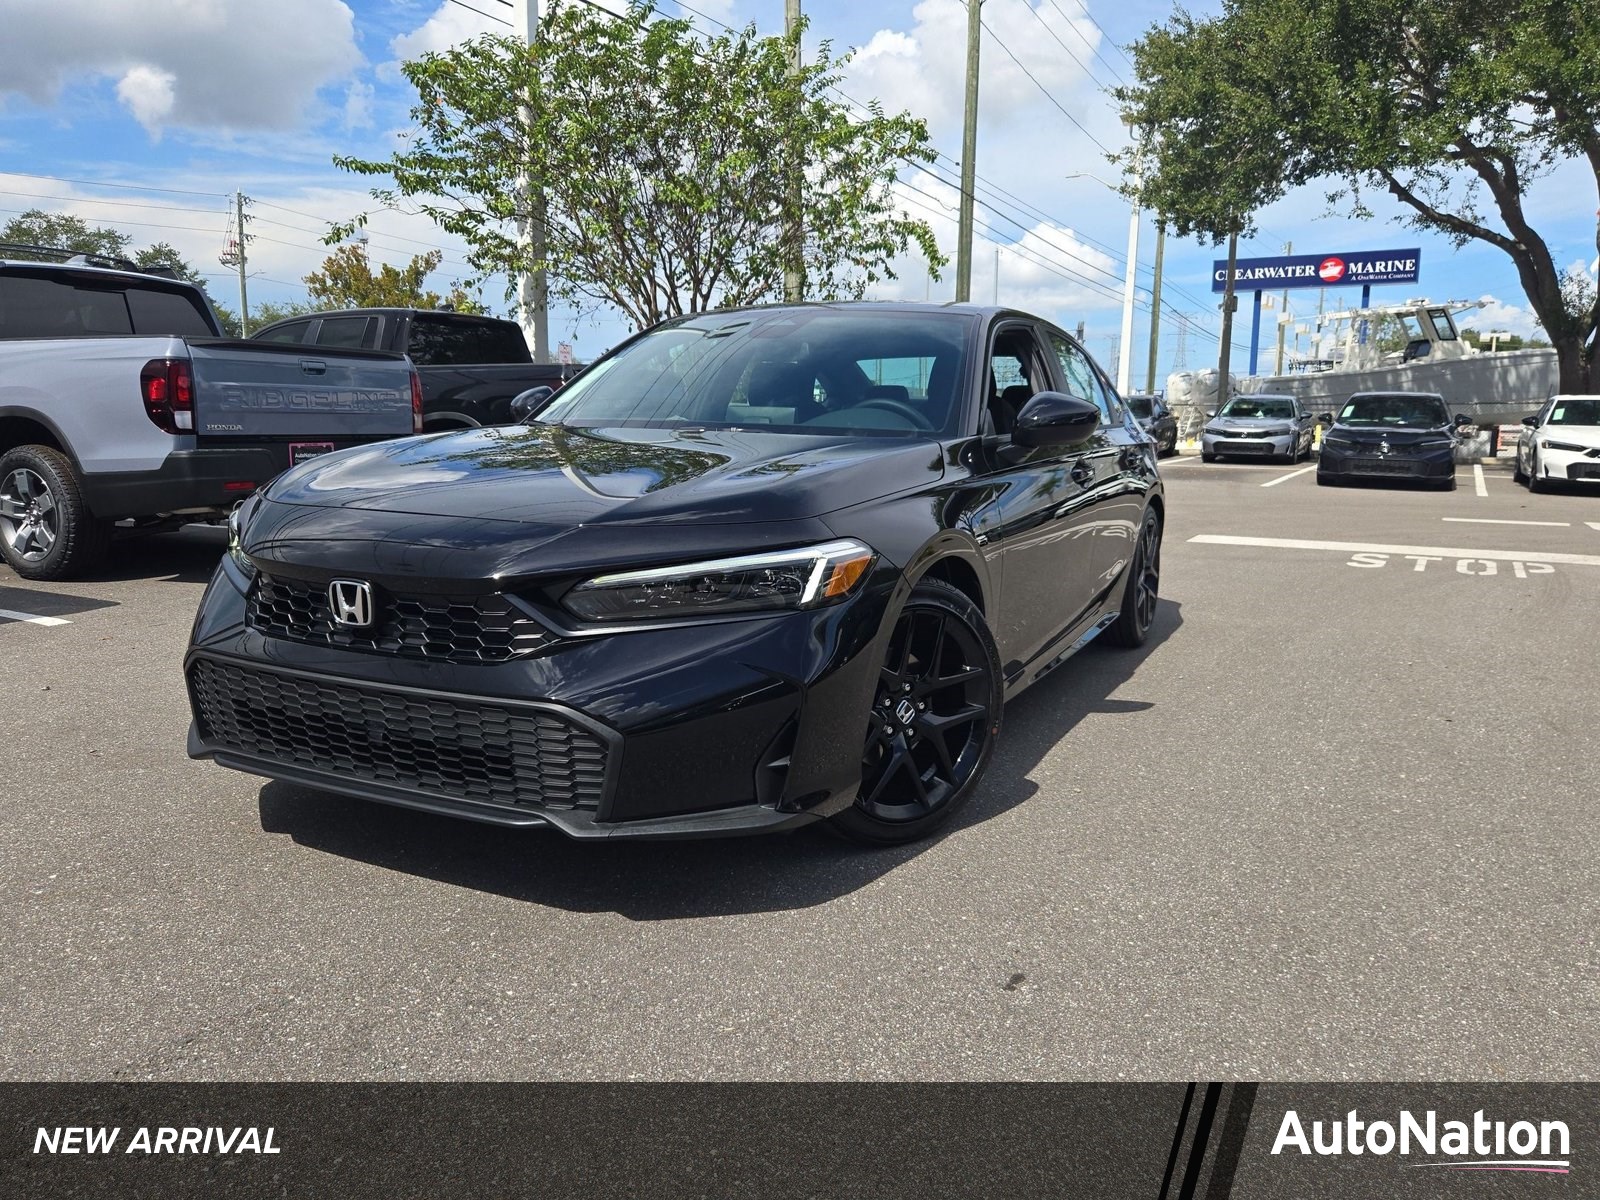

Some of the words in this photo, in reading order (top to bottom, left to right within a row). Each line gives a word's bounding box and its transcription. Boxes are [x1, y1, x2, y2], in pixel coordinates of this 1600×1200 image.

[1215, 265, 1315, 281] CEARWATER
[1348, 259, 1415, 274] MARINE
[221, 388, 400, 412] RIDGELINE
[1346, 552, 1555, 579] STOP
